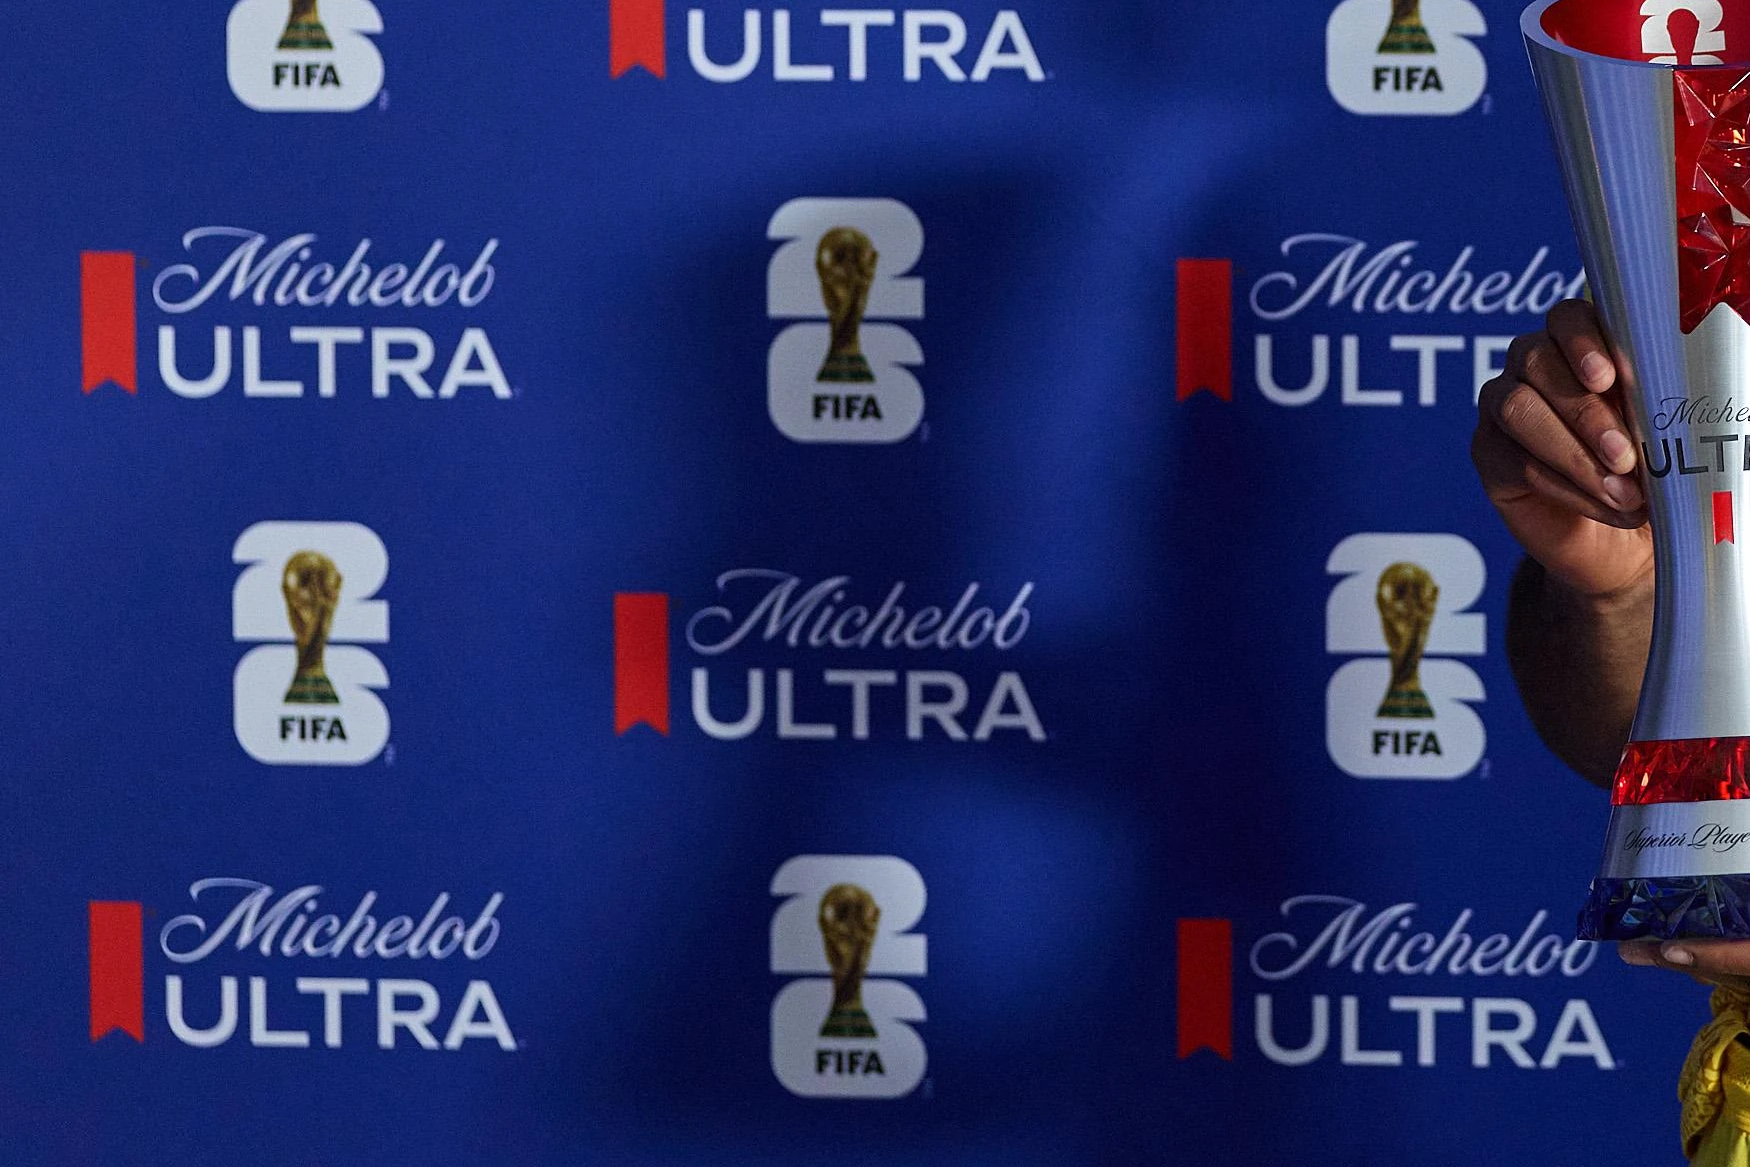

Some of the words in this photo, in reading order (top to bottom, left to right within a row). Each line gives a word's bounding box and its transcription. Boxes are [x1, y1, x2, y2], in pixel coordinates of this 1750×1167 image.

[273, 63, 342, 87] FIFA
[688, 9, 1044, 82] ULTRA
[1373, 65, 1444, 92] FIFA
[153, 227, 497, 313] Michelob
[1250, 232, 1587, 320] Michelo
[159, 325, 512, 398] ULTRA
[1255, 334, 1517, 406] ULT
[813, 393, 883, 420] FIFA
[688, 569, 1034, 654] Michelob
[280, 716, 348, 741] FIFA
[692, 667, 1044, 740] ULTRA
[1372, 729, 1443, 756] FIFA
[1623, 827, 1686, 857] Superior
[161, 878, 502, 962] Michelob
[166, 975, 516, 1050] ULTRA
[1254, 993, 1616, 1069] ULTRA
[815, 1048, 886, 1075] FIFA
